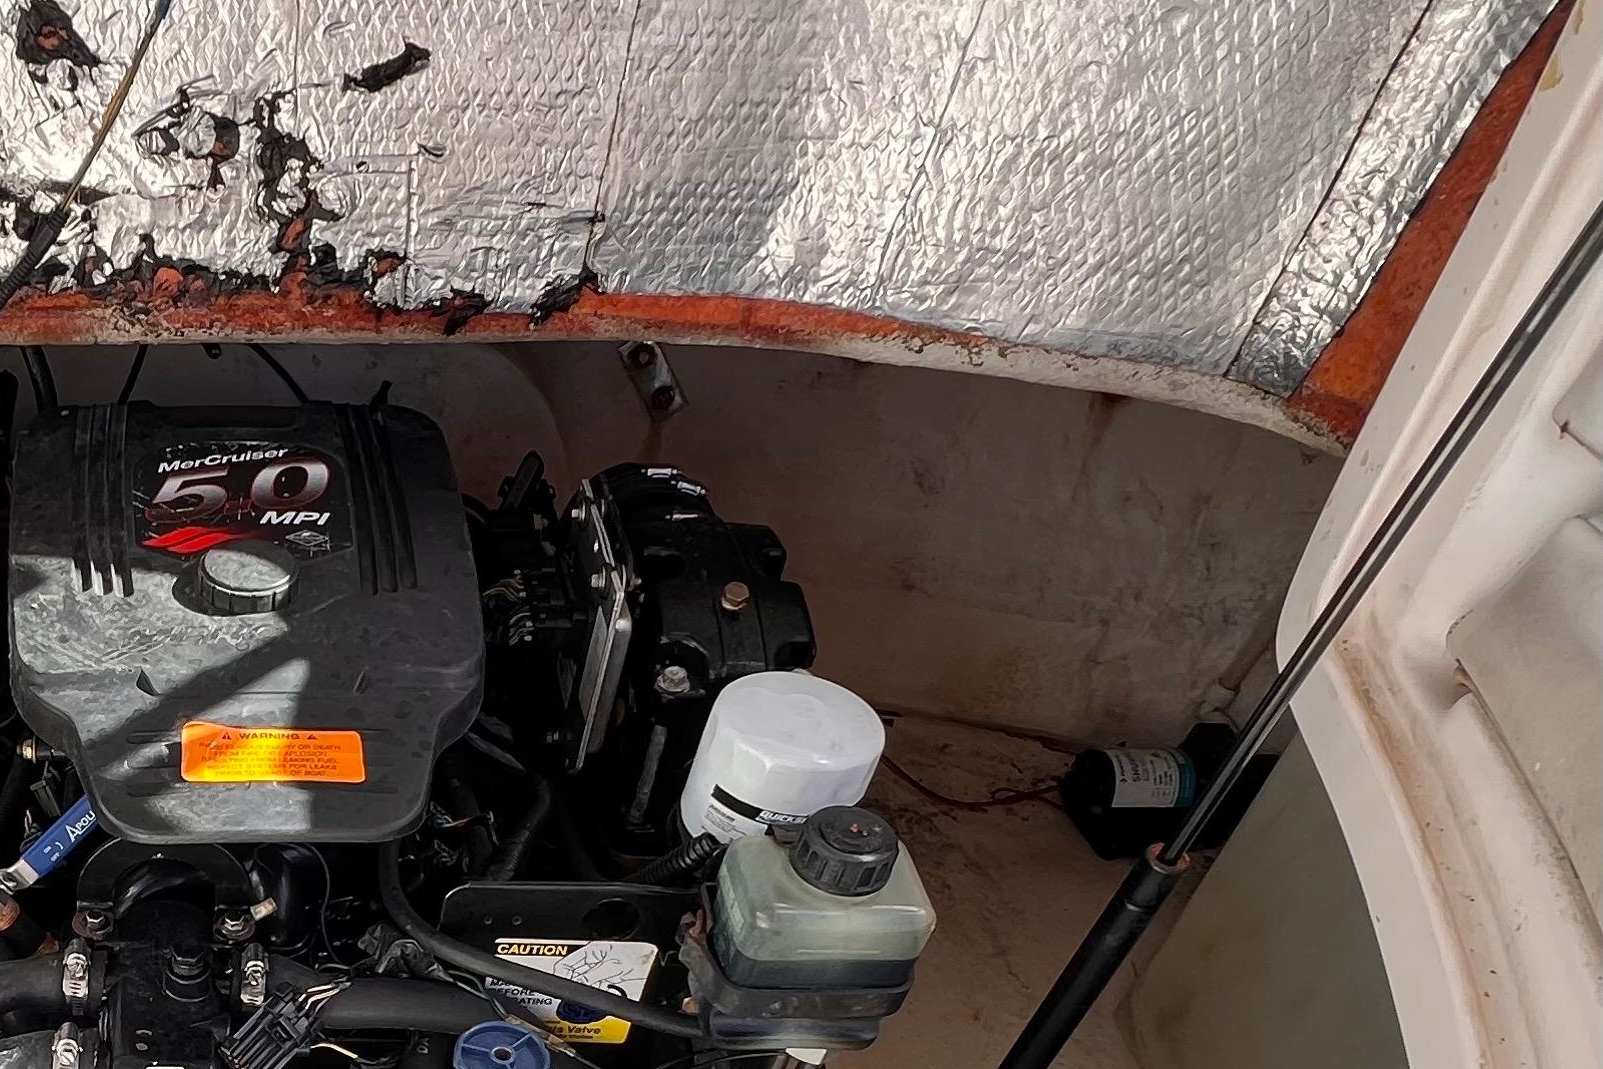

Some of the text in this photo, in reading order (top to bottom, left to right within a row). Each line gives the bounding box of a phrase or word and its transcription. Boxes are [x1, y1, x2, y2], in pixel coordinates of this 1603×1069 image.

[158, 448, 289, 473] MerCruiser
[145, 459, 330, 523] 5.0
[259, 511, 331, 525] MPI
[239, 732, 300, 740] WARNING
[497, 944, 568, 956] CAUTION
